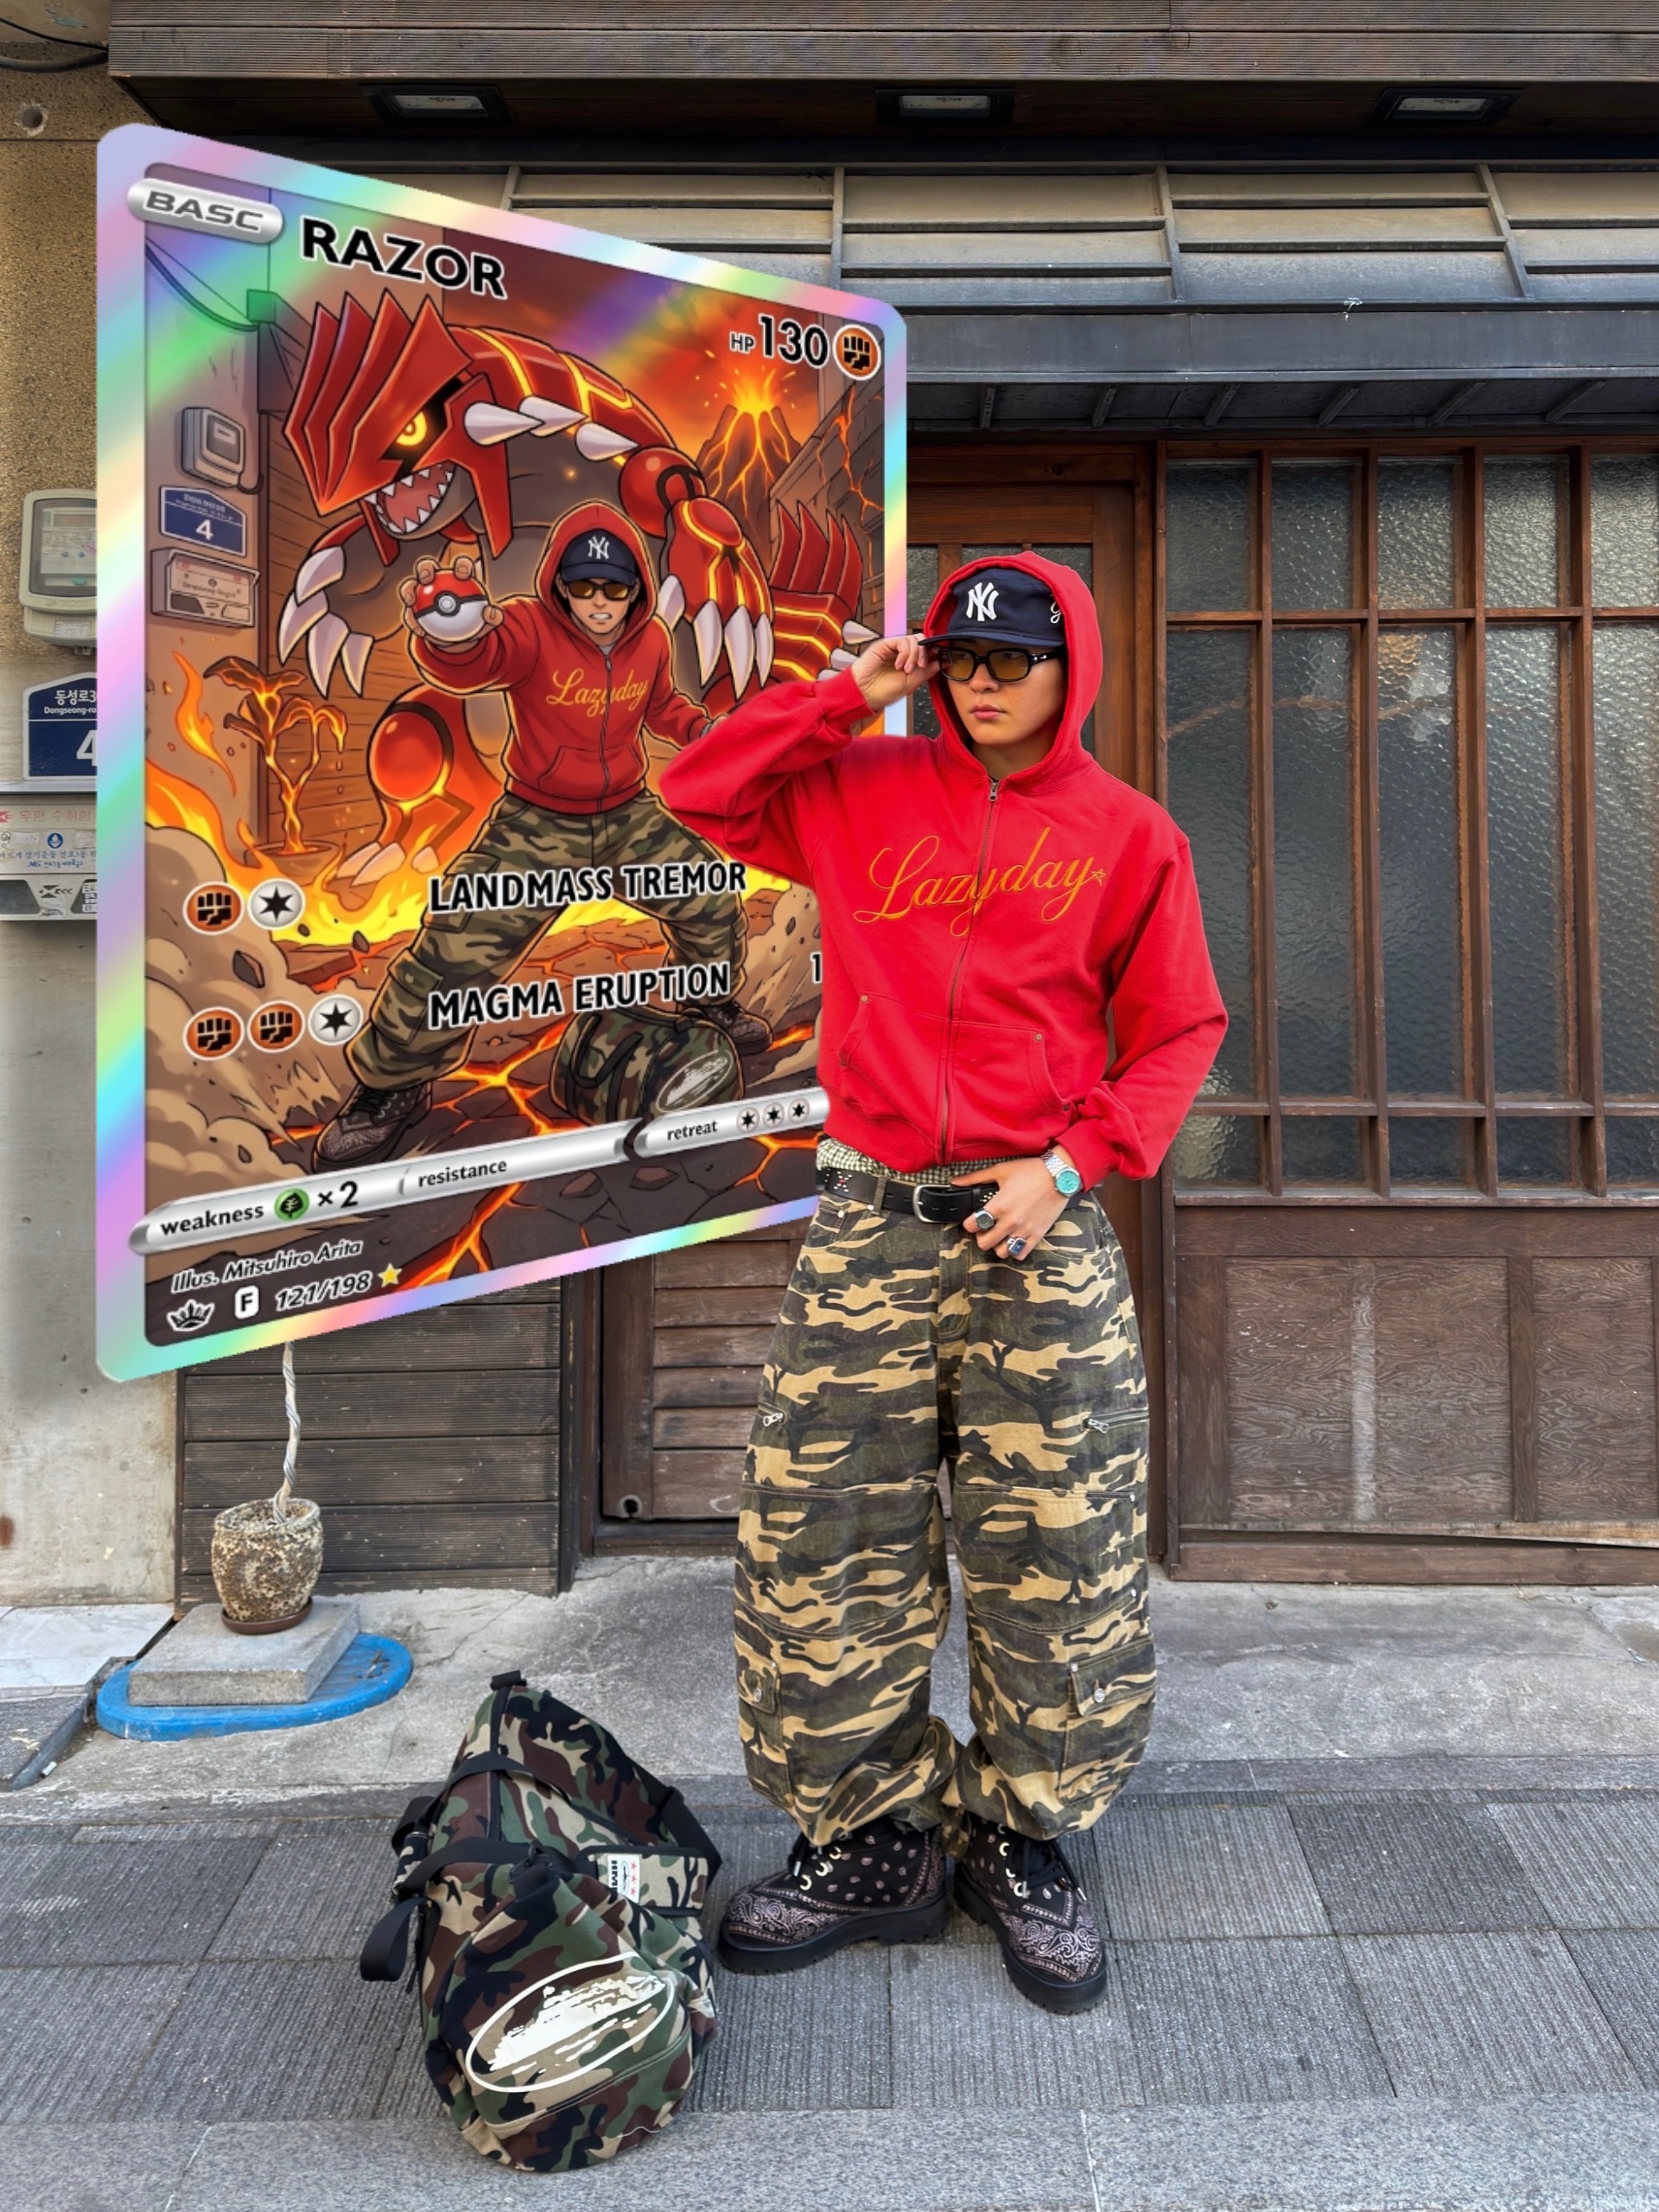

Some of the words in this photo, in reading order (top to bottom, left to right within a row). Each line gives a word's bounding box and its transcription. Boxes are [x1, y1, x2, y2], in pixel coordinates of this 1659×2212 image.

[966, 582, 999, 621] NY
[44, 706, 97, 715] Dongseong-ro
[20, 810, 45, 822] 우편
[853, 826, 1099, 936] Lazyday
